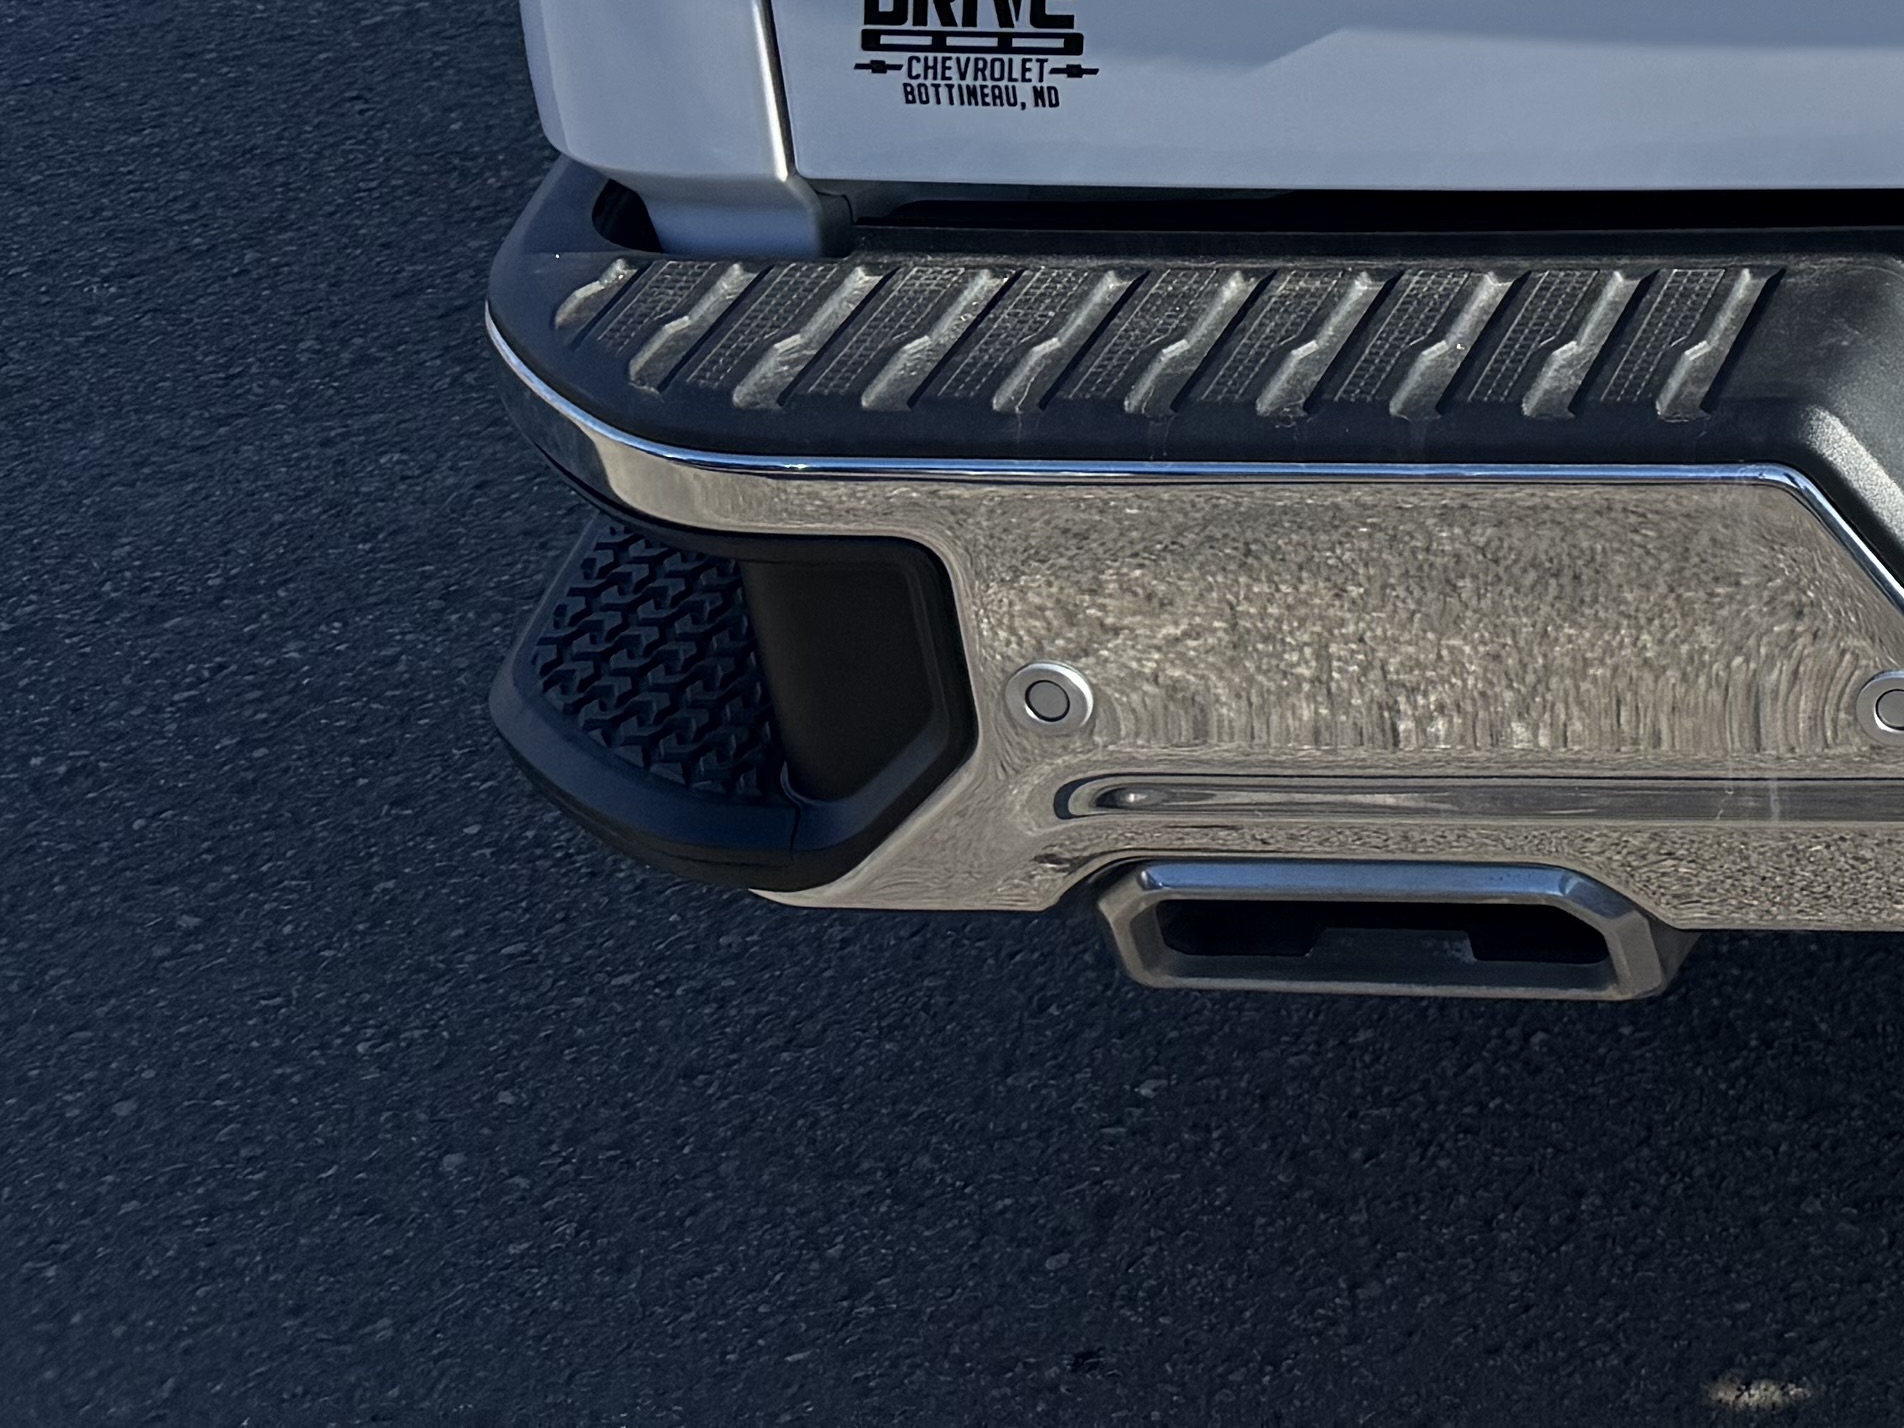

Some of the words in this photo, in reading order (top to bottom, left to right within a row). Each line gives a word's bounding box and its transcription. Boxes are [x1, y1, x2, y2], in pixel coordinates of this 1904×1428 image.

[906, 55, 1049, 83] CHEVROLET
[902, 82, 1027, 111] BOTTINEAU,
[1032, 85, 1061, 108] ND
